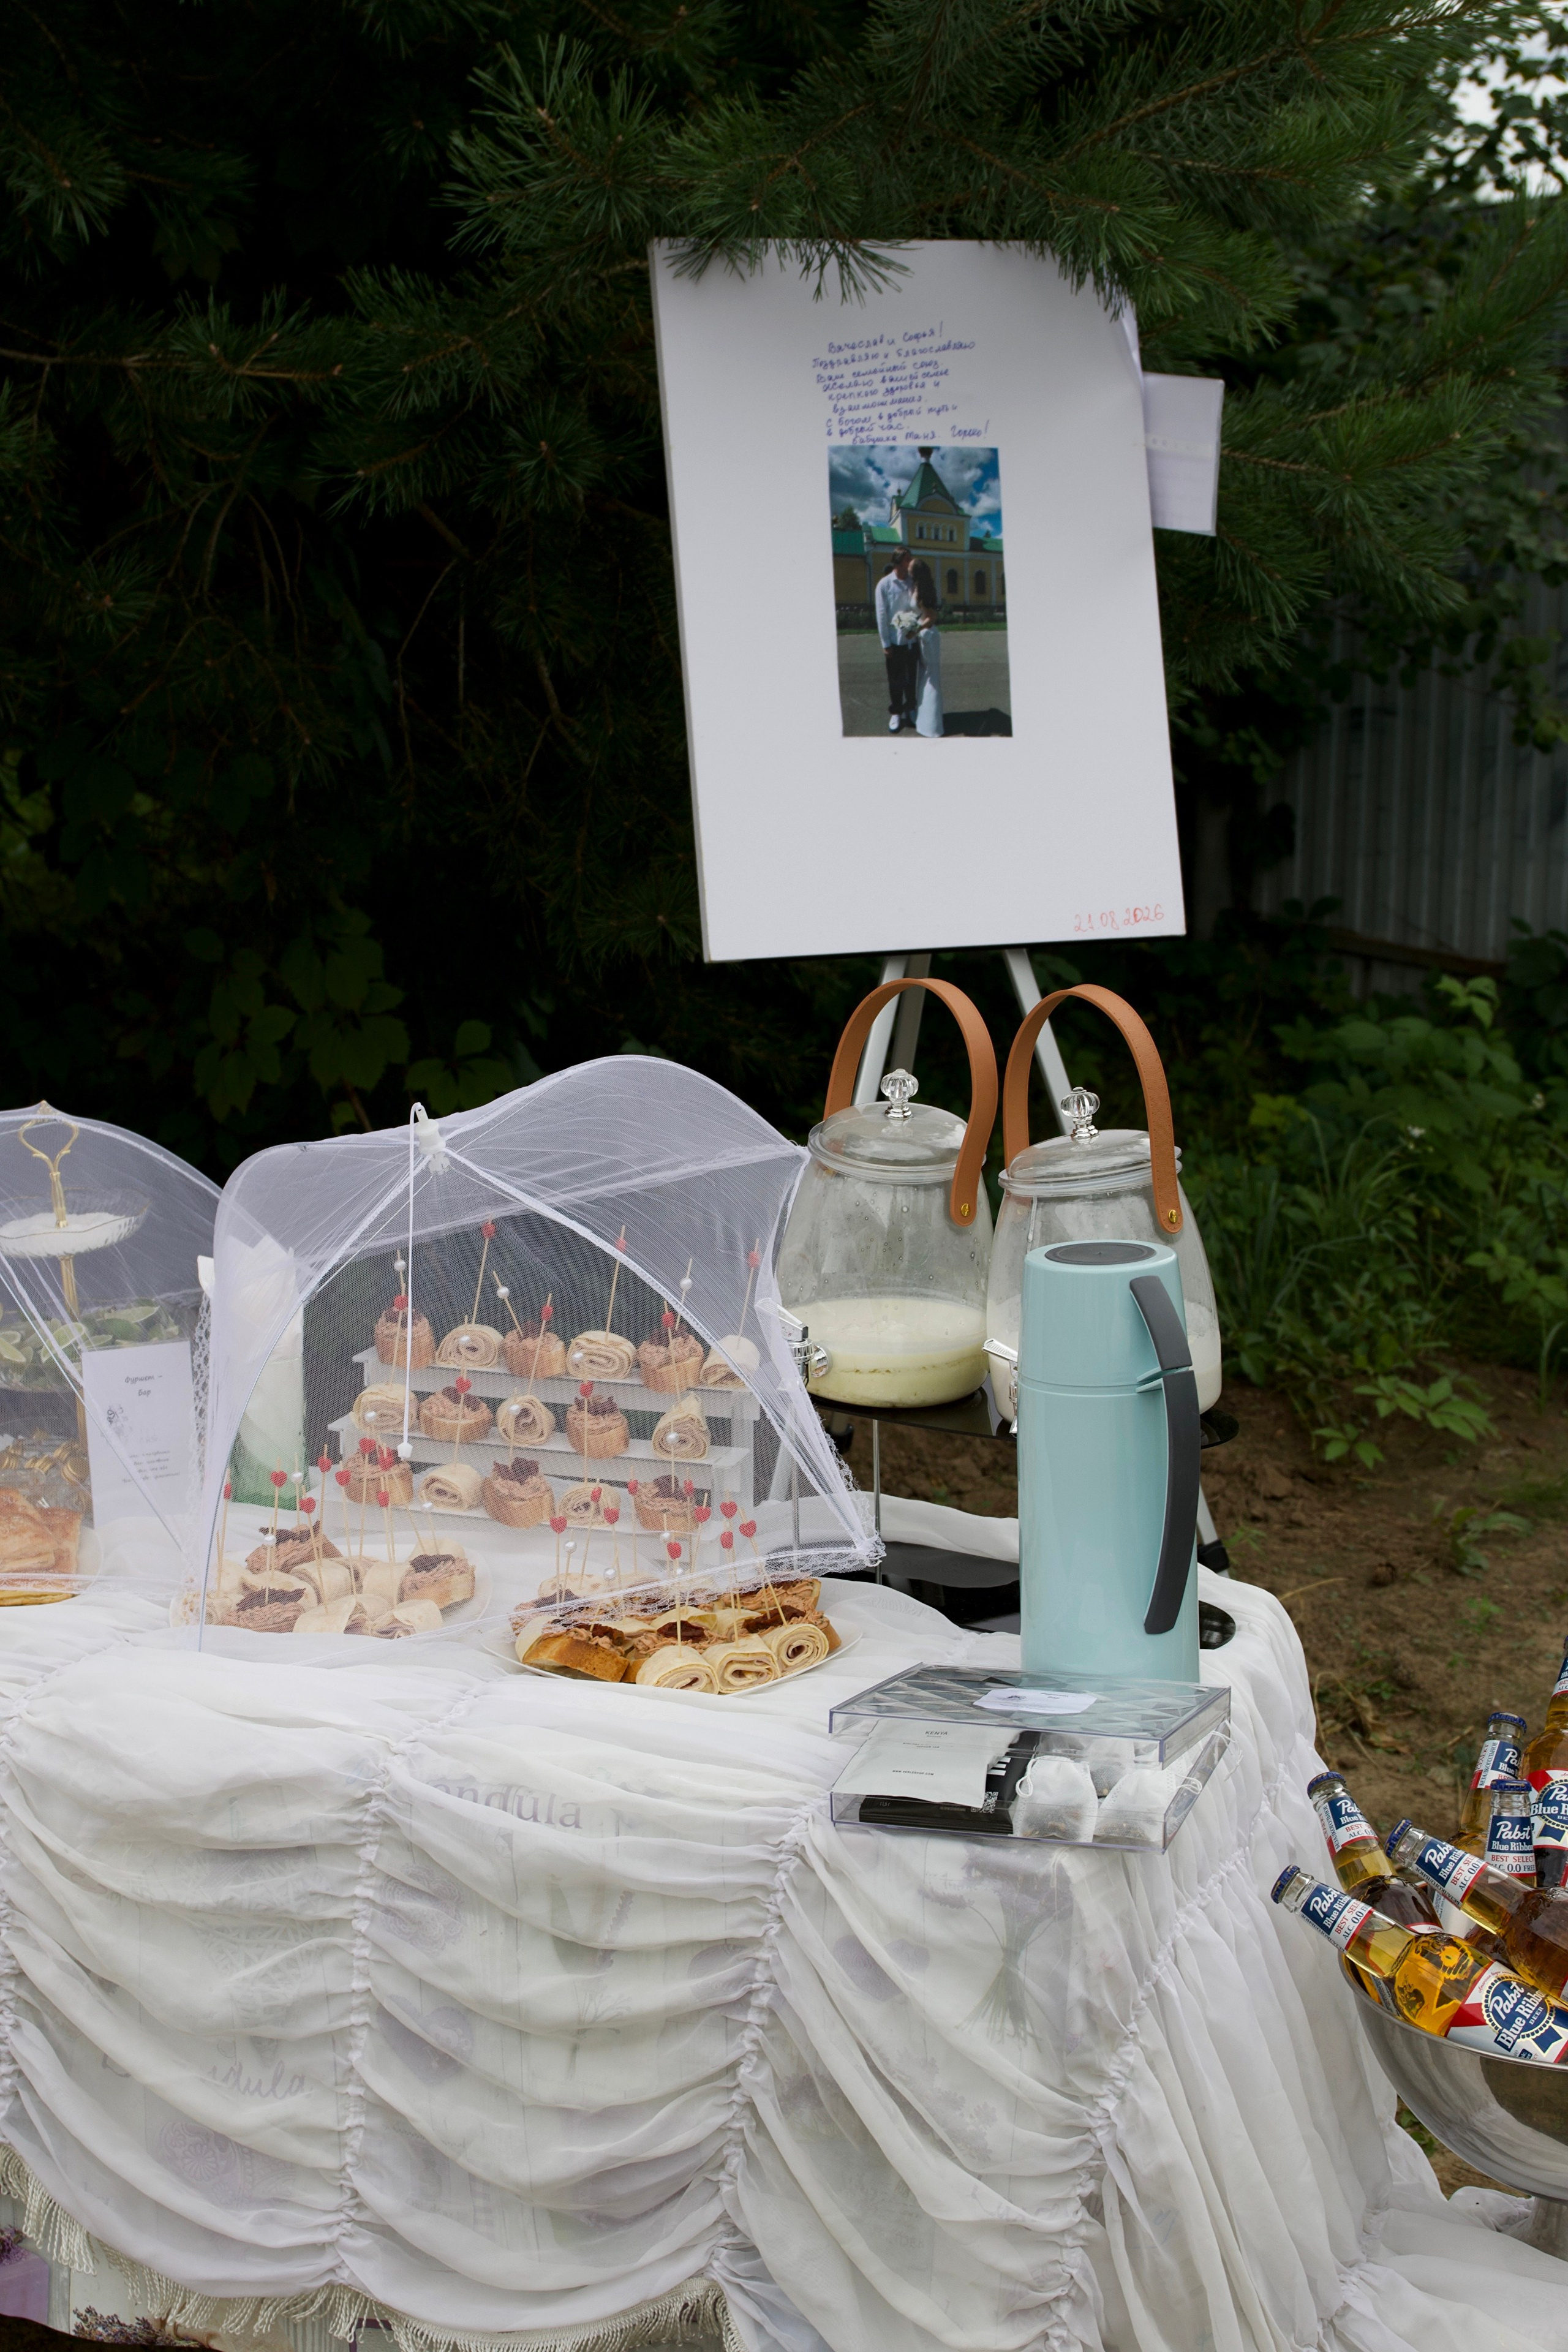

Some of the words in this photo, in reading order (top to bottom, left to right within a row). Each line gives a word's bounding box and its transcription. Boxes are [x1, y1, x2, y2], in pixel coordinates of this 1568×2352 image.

[1479, 1741, 1498, 1787] БЕЗАЛКОГОЛЬНОЕ
[1531, 1803, 1559, 1816] Blue
[1323, 1804, 1340, 1850] БЕЗАЛКОГОЛЬНОЕ
[1340, 1815, 1359, 1825] Blue
[1345, 1823, 1363, 1833] BEST
[1496, 1820, 1531, 1840] Pabst
[1491, 1841, 1509, 1850] Blue
[1438, 1862, 1456, 1880] Blue
[1450, 1866, 1465, 1886] BEST
[1507, 1863, 1521, 1872] 0.0
[1322, 1907, 1339, 1929] Blue
[1334, 1914, 1349, 1935] BEST
[1351, 1910, 1365, 1924] 0.0
[1488, 1980, 1525, 2021] Pabst
[1528, 2006, 1544, 2025] BEER
[1496, 2016, 1527, 2049] Blue
